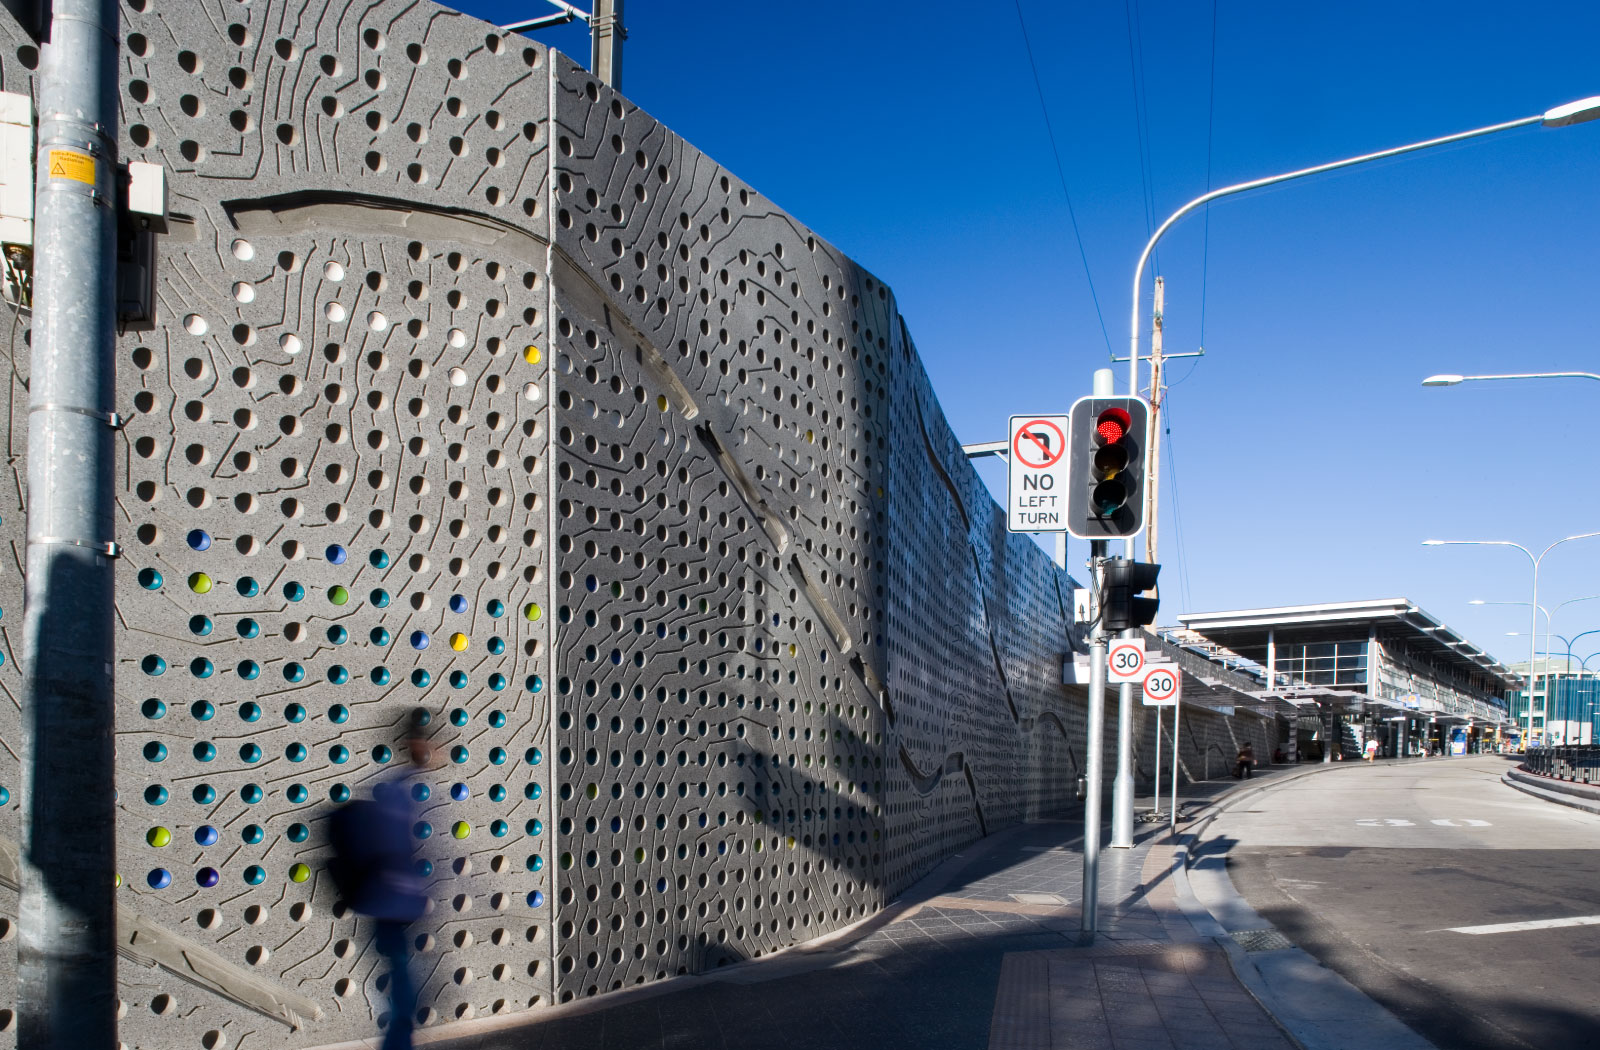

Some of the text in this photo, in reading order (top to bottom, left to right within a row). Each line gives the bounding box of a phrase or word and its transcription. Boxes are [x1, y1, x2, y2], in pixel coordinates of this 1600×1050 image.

[1023, 473, 1054, 491] NO
[1019, 495, 1058, 507] LEFT
[1018, 512, 1059, 524] TURN
[1116, 652, 1139, 669] 30
[1150, 678, 1172, 692] 30
[1354, 818, 1493, 827] 30
